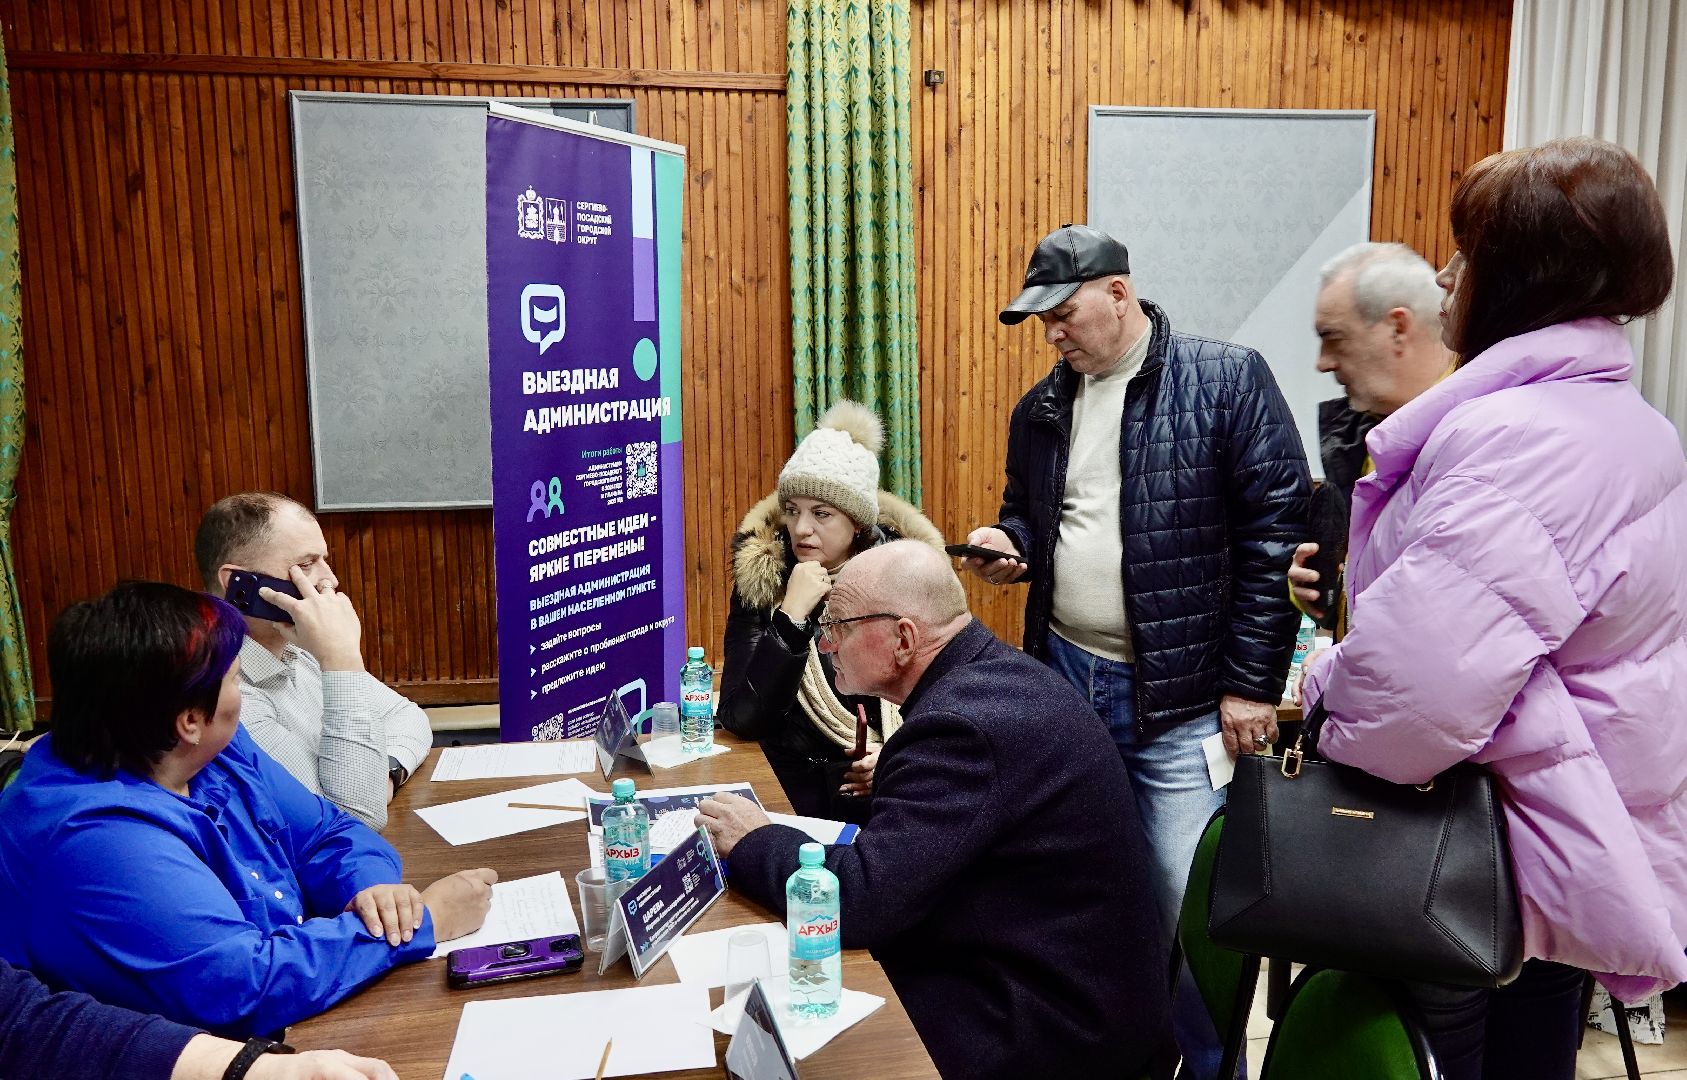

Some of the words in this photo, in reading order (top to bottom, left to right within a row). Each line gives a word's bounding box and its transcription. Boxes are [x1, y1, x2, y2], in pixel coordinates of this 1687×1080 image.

[577, 236, 598, 245] ОКРУГ
[522, 367, 619, 395] ВЫЕЗДНАЯ
[523, 396, 671, 435] АДМИНИСТРАЦИЯ
[581, 449, 602, 459] Итоги
[528, 520, 616, 557] СОВМЕСТНЫЕ
[617, 512, 649, 535] ИДЕИ
[529, 555, 570, 583] ЯРКИЕ
[573, 535, 645, 569] ПЕРЕМЕНЫ!
[529, 585, 577, 612] ВЫЕЗДНАЯ
[577, 563, 651, 595] АДМИНИСТРАЦИЯ
[530, 618, 538, 631] В
[538, 607, 567, 628] ВАШЕМ
[567, 589, 626, 617] НАСЕЛЕННОМ
[626, 579, 657, 598] ПУНКТЕ
[540, 632, 568, 651] задайте
[567, 622, 602, 640] вопросы
[541, 648, 582, 675] расскажите
[583, 646, 589, 655] о
[626, 625, 649, 641] города
[649, 623, 654, 631] и
[654, 615, 675, 631] округа
[541, 668, 585, 695] предложите
[585, 661, 606, 677] идею
[684, 693, 710, 702] АРХЫЗ
[605, 847, 640, 859] АРХЫЗ
[642, 899, 665, 924] ЦАРЕВА
[798, 919, 838, 936] АРХЫЗ
